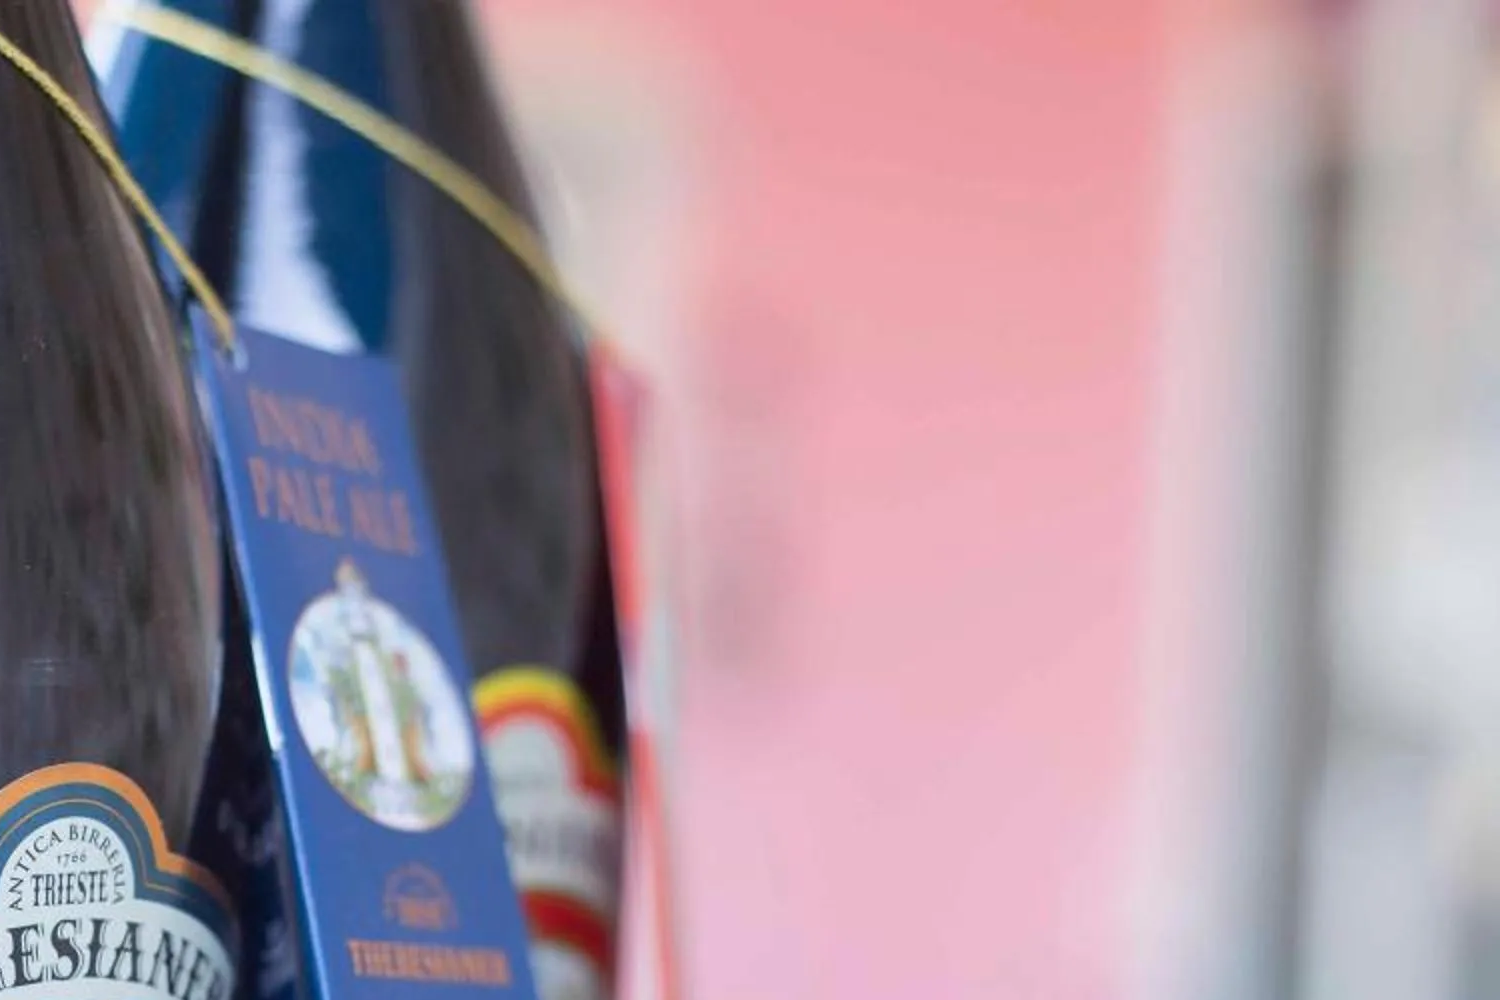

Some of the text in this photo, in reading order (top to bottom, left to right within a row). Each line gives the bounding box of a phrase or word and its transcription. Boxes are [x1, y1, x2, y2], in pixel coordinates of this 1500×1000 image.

[249, 384, 380, 476] INDIA
[248, 455, 420, 557] PALE ALE
[8, 821, 127, 911] ANTICA BIRRERIA
[31, 869, 111, 907] TRIESTE
